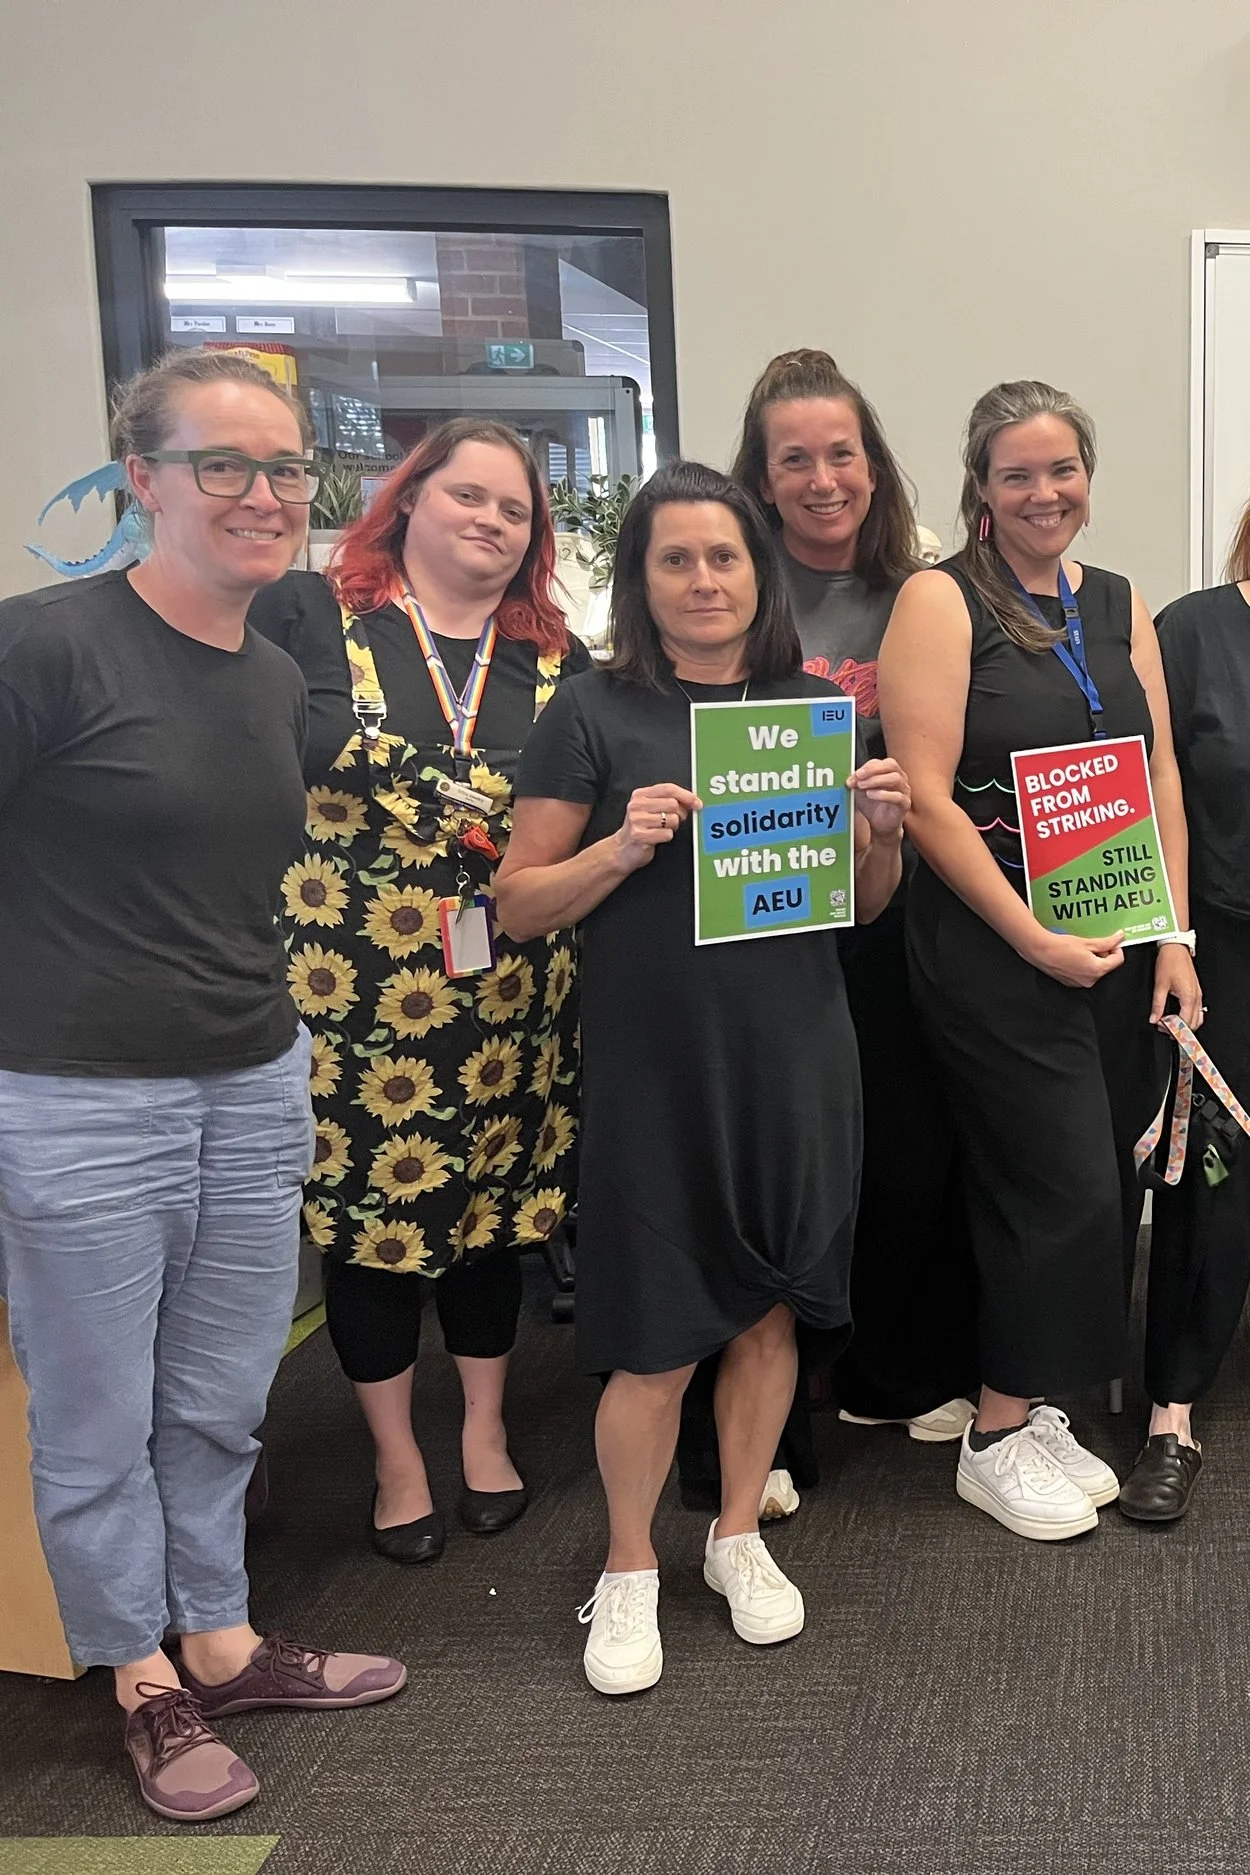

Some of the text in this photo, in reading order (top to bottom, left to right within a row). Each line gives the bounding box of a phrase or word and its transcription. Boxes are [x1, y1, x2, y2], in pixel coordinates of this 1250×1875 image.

[822, 710, 845, 722] IEU
[748, 725, 799, 751] We
[709, 761, 834, 795] stand in
[1025, 754, 1119, 794] BLOCKED
[1030, 785, 1091, 817] FROM
[710, 802, 840, 840] solidarity
[1035, 798, 1136, 839] STRIKING.
[714, 845, 837, 878] with the
[1102, 844, 1152, 866] STILL
[1048, 866, 1156, 899] STANDING
[752, 888, 802, 916] AEU
[1052, 888, 1161, 921] WITH AEU.
